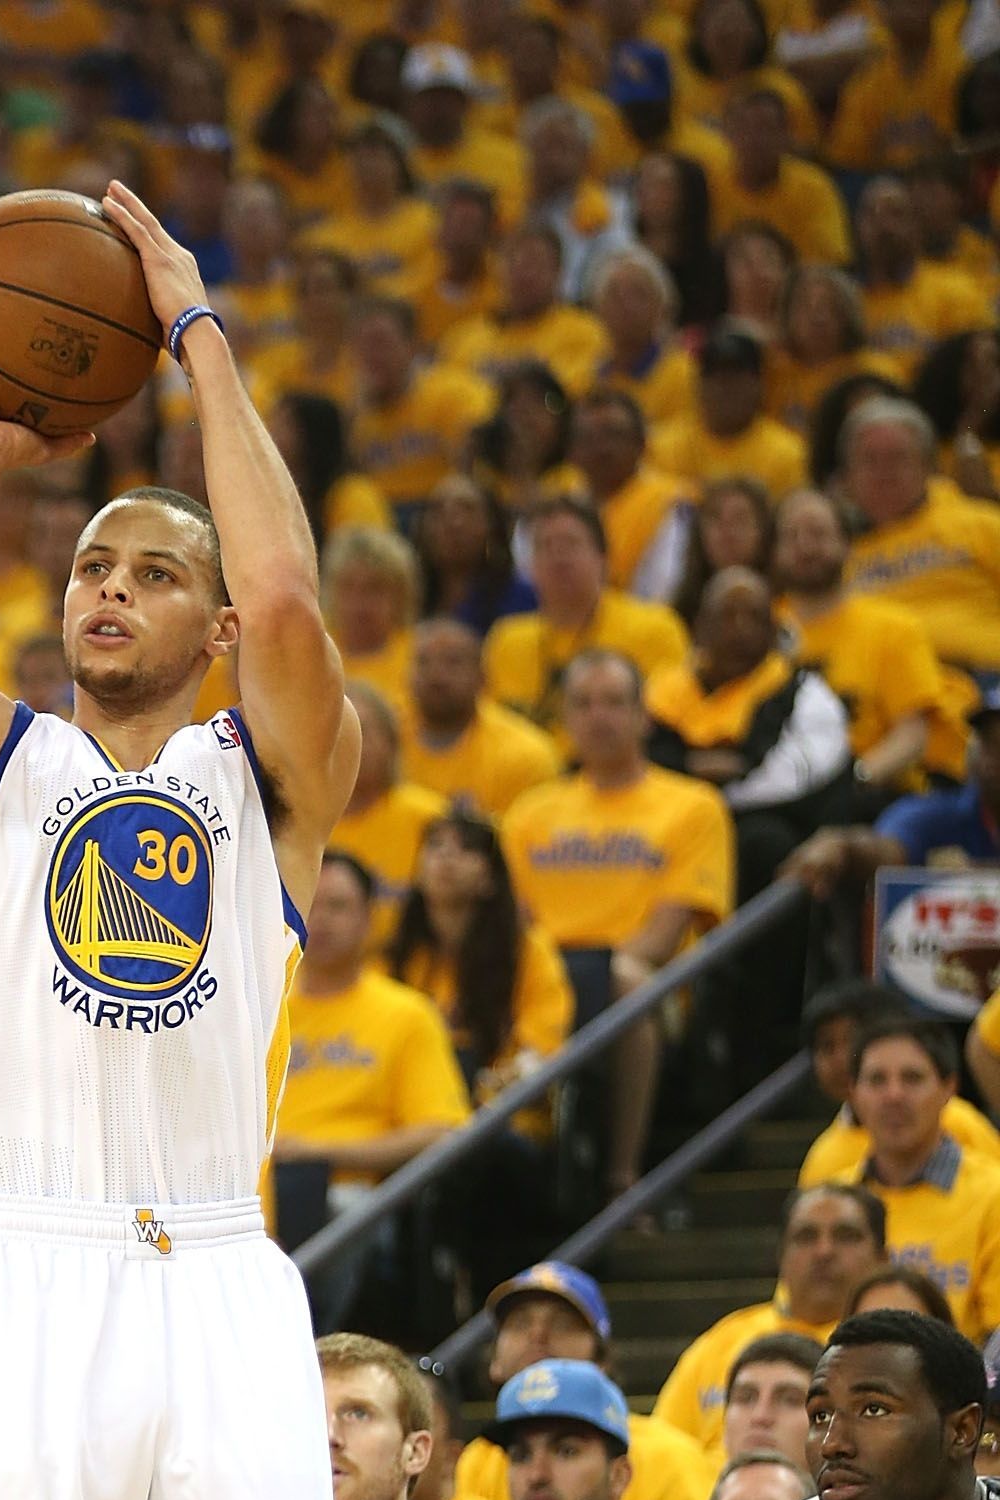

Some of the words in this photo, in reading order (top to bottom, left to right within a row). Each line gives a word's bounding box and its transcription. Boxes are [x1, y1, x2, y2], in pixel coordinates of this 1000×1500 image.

[42, 772, 154, 837] GOLDEN
[166, 775, 232, 846] STATE
[133, 828, 198, 886] 30
[52, 965, 218, 1034] WARRIORS
